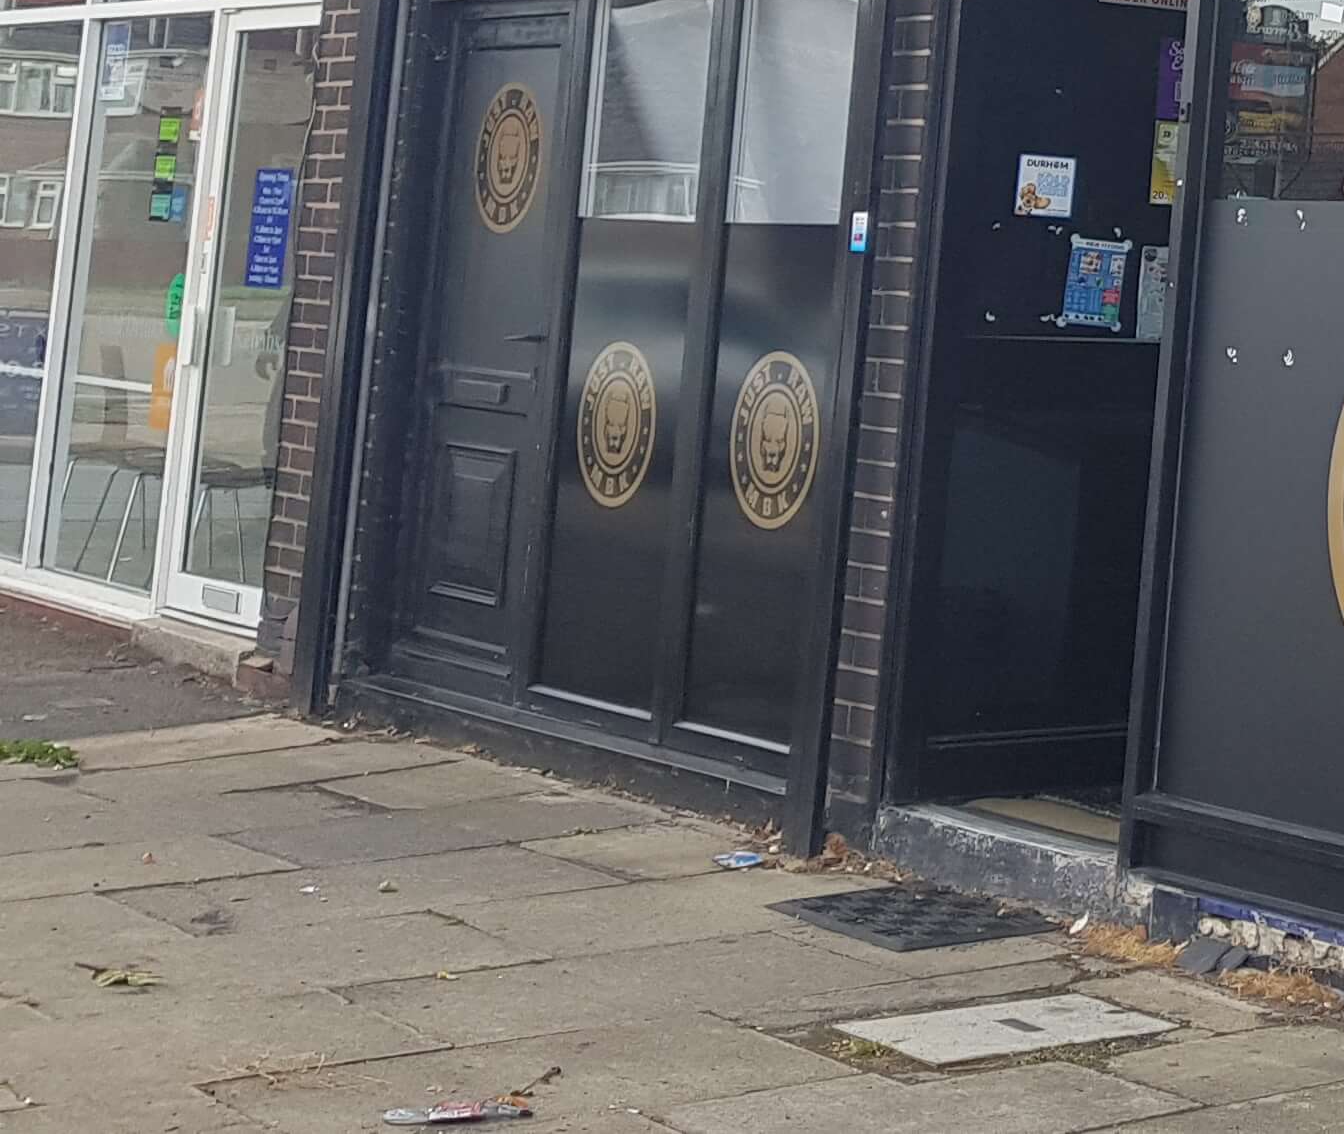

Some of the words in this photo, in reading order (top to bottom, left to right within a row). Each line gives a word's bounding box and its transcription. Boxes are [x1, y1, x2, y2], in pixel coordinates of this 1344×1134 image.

[587, 353, 614, 410] JUST
[632, 355, 649, 409] RAW
[741, 362, 771, 426] JUST
[787, 368, 812, 425] RAW
